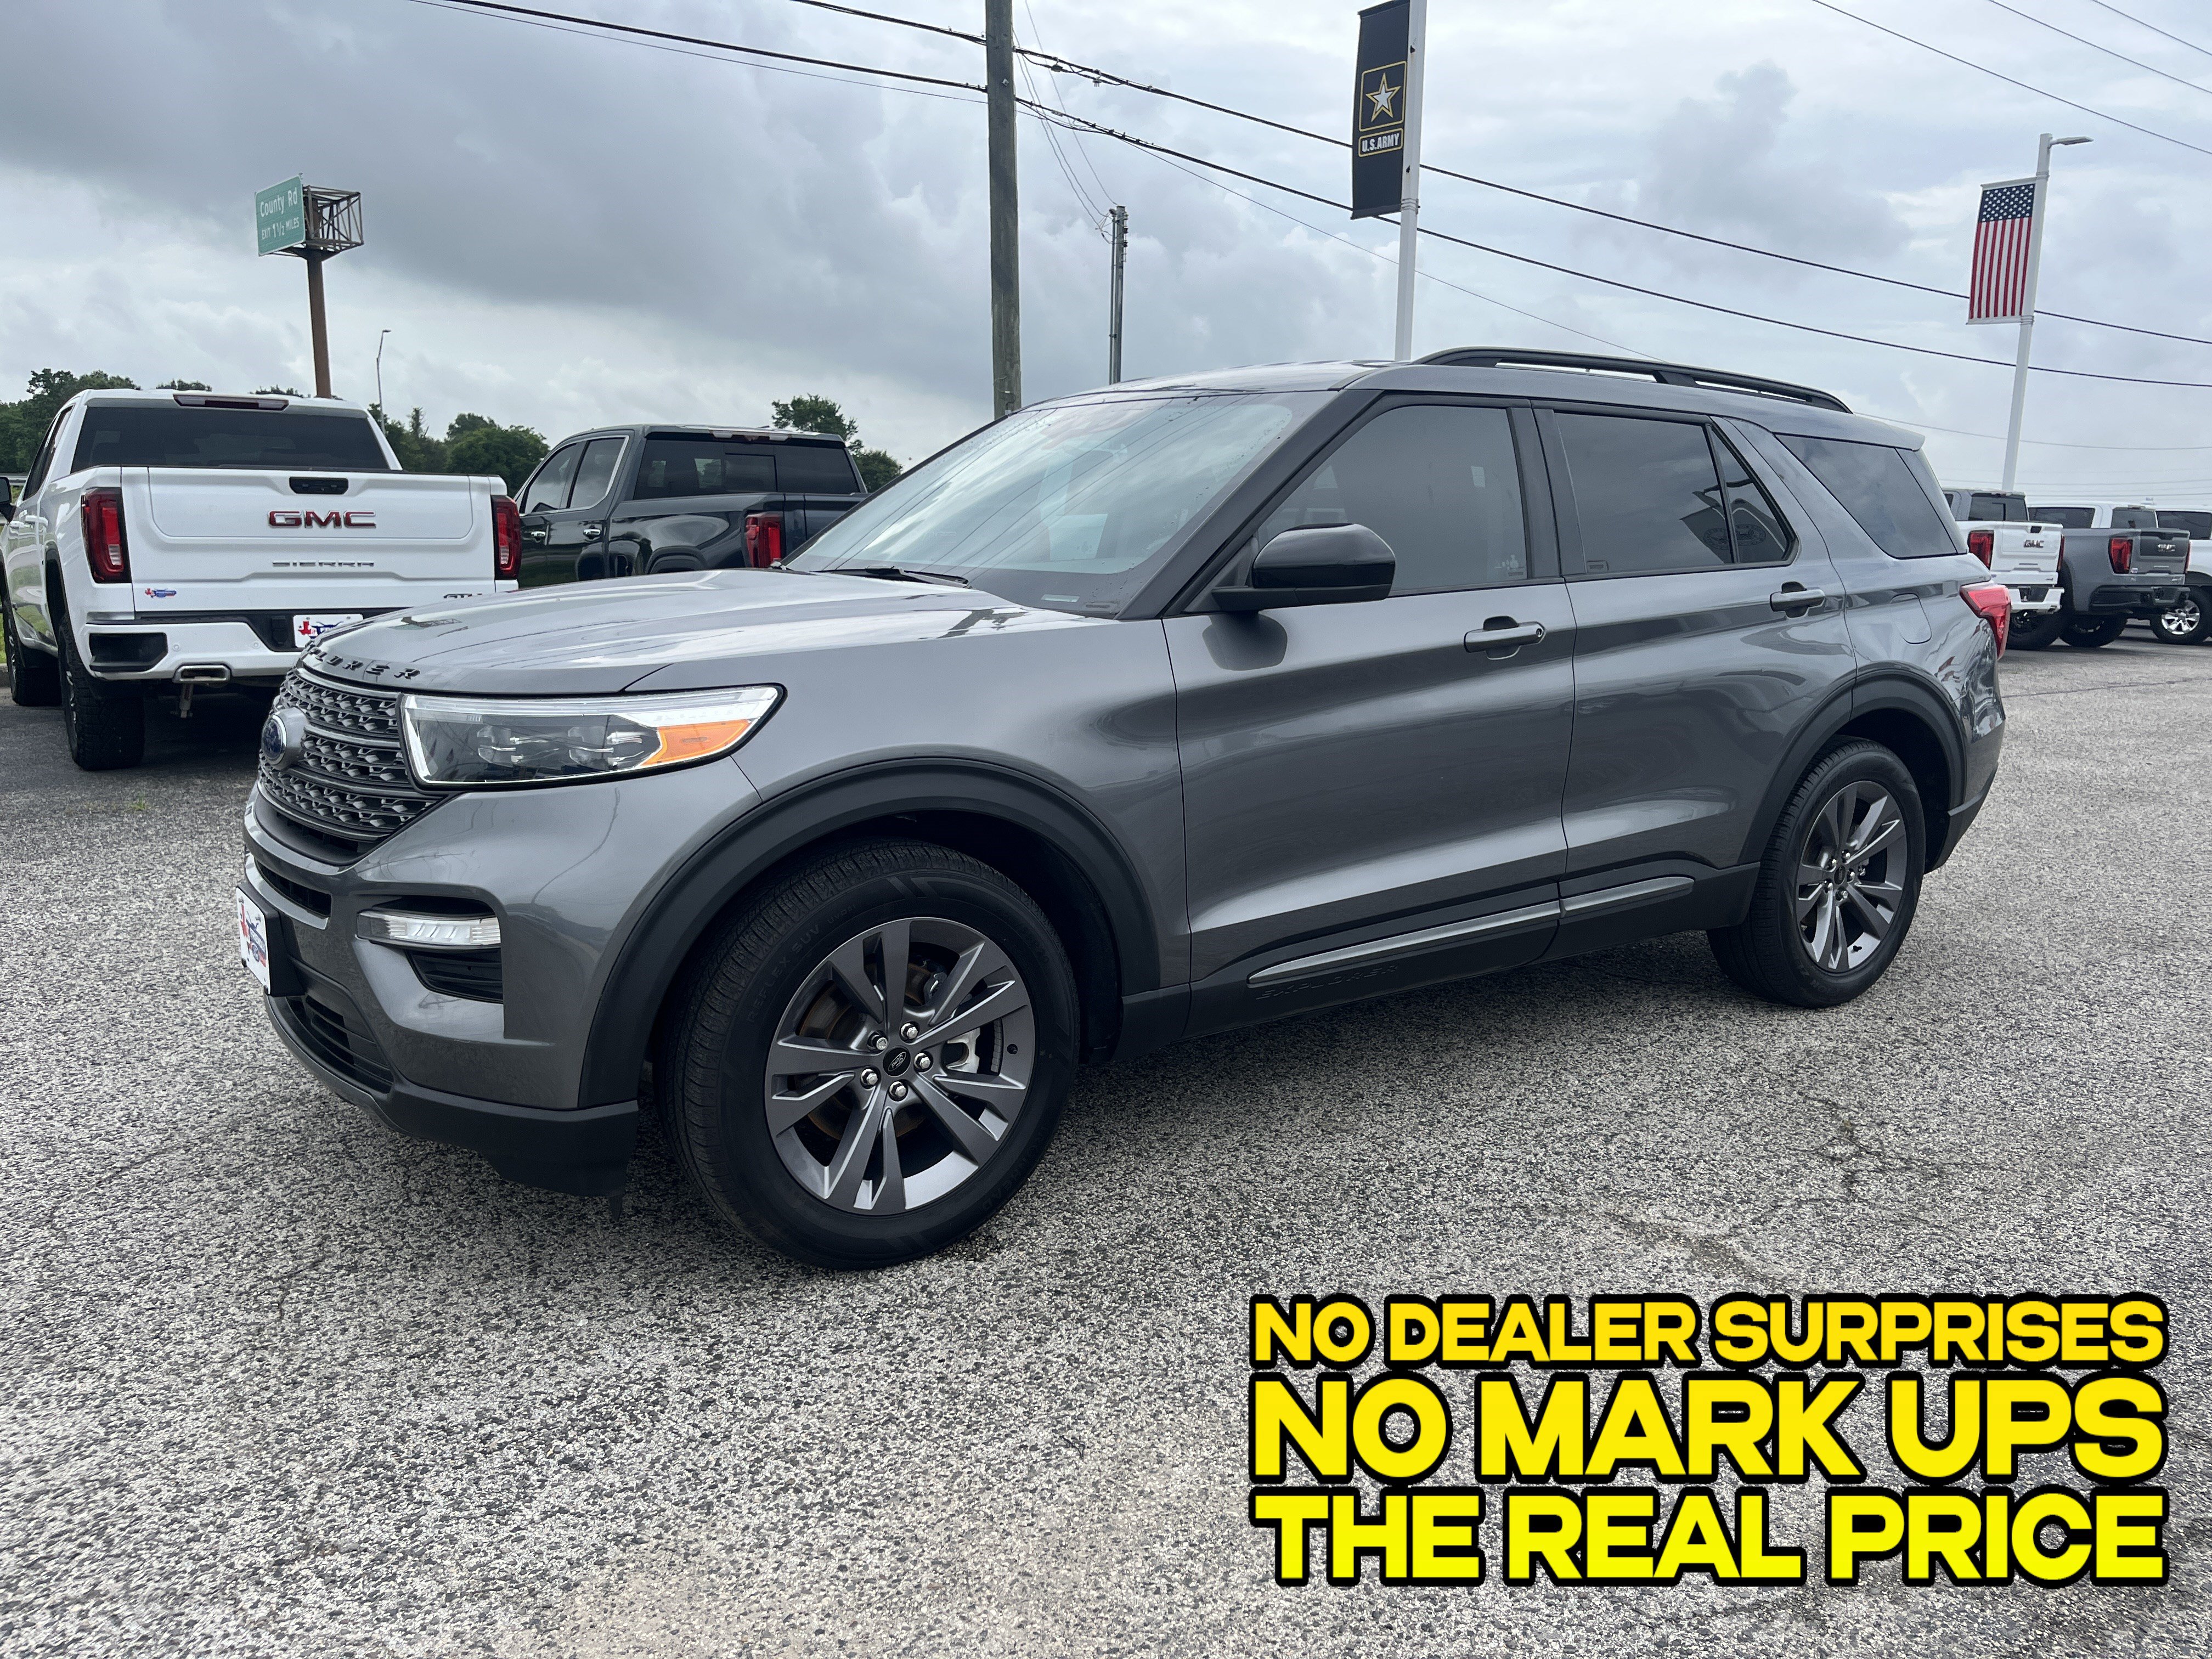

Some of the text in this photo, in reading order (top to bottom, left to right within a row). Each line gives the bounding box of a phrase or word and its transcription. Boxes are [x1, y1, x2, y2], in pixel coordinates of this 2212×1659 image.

[260, 188, 297, 217] County Rd
[262, 228, 270, 240] EXIT
[286, 217, 300, 231] MILES
[268, 510, 376, 529] GMC
[2023, 539, 2045, 548] GMC
[792, 924, 820, 954] SUV
